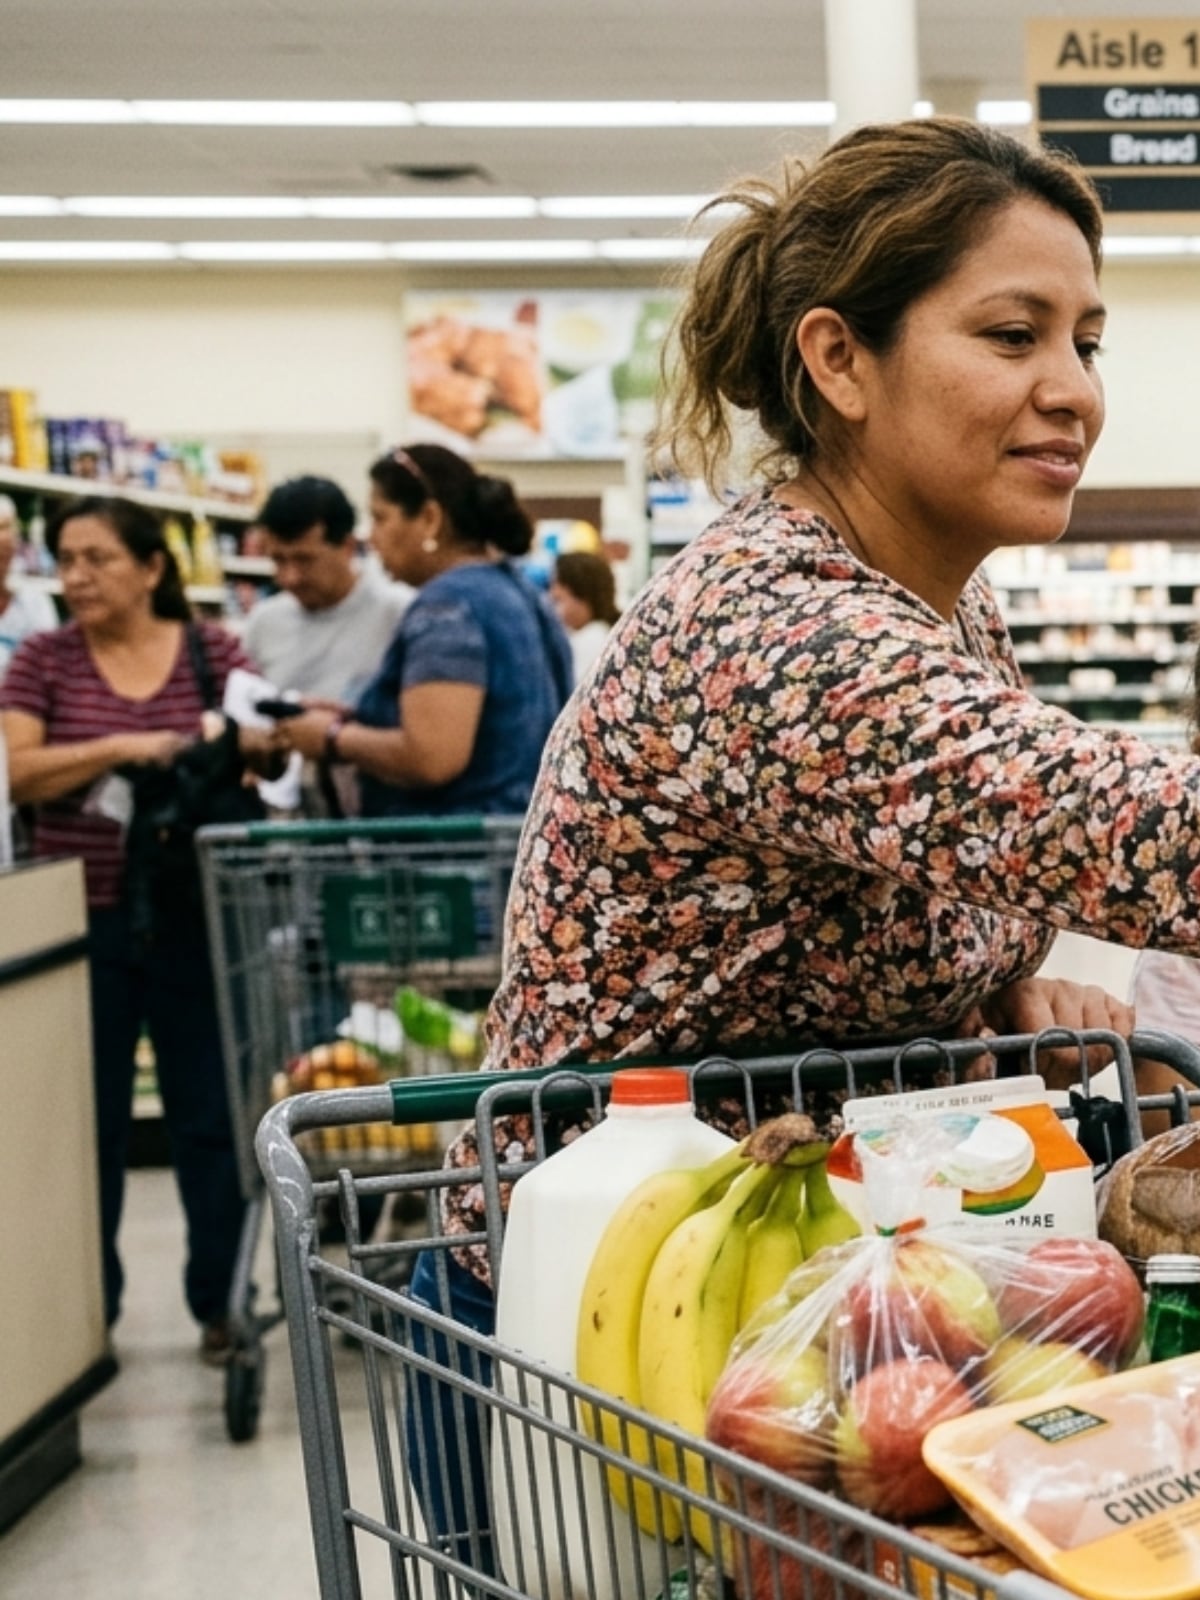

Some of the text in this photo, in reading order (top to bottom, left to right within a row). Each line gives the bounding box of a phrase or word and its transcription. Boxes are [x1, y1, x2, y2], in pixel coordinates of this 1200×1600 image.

[1055, 32, 1166, 69] Aisle
[1103, 88, 1200, 118] Grains
[1110, 134, 1198, 164] Bread
